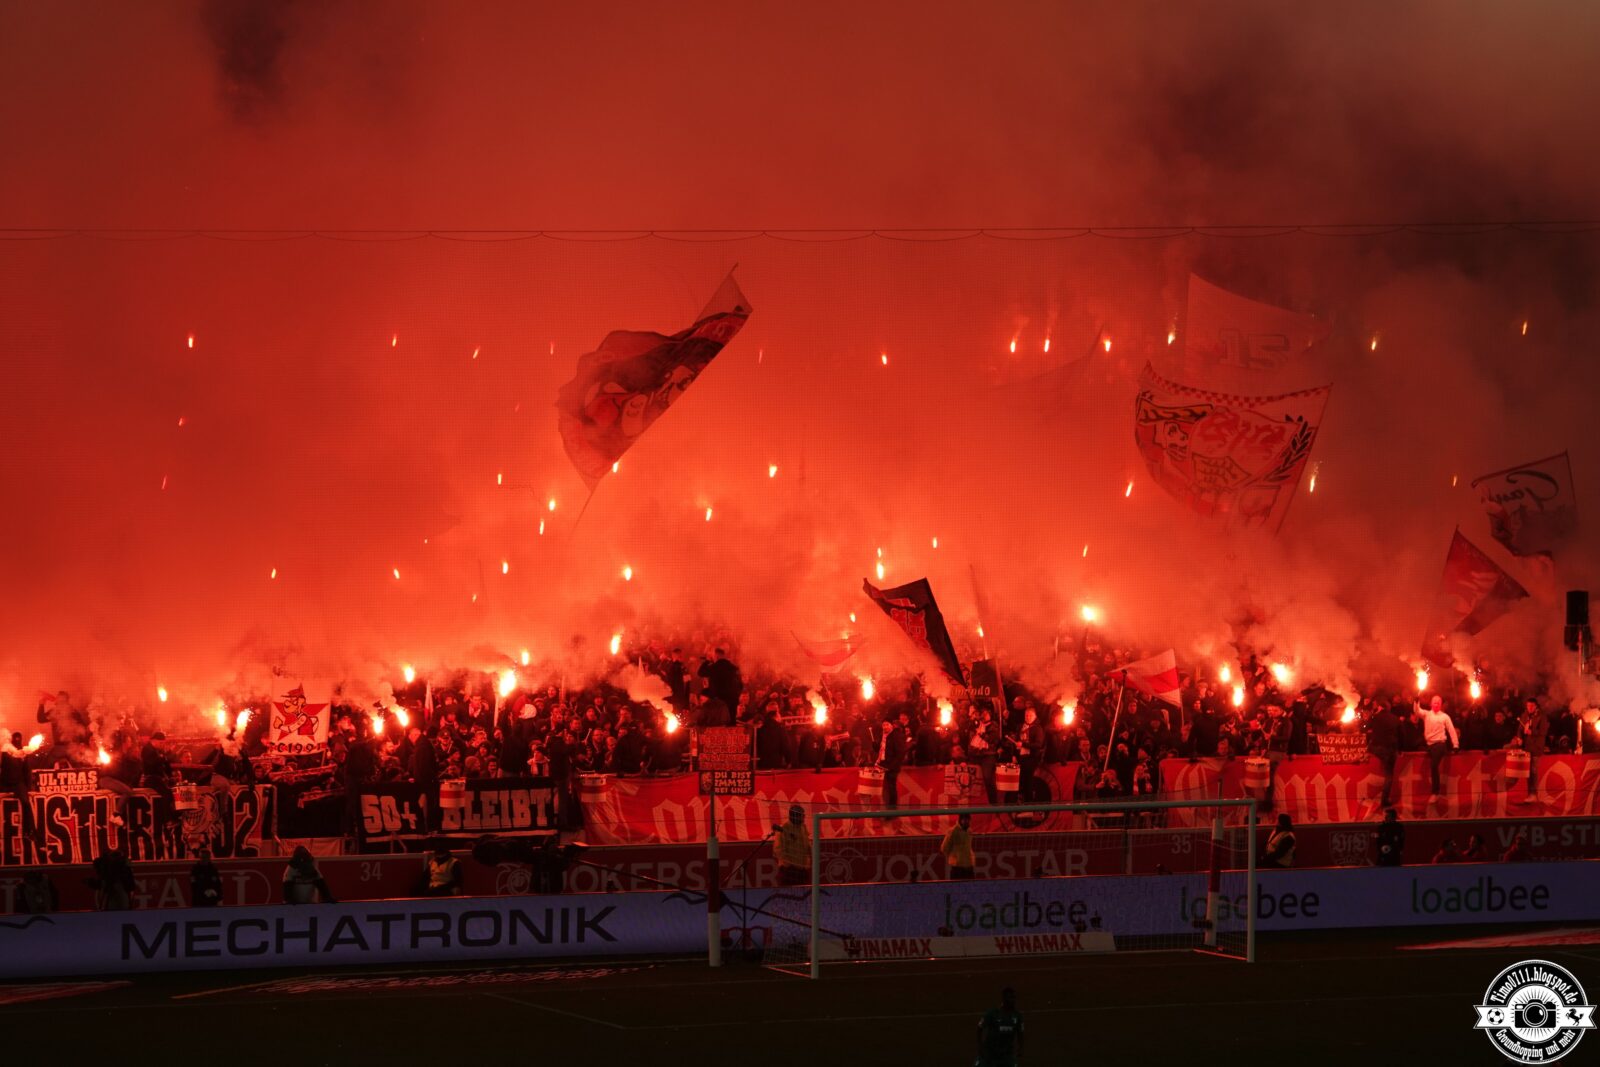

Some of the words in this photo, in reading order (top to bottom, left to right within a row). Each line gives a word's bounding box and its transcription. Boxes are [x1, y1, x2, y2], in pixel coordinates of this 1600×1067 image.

[39, 770, 98, 787] ULTRAS
[714, 771, 728, 779] DU
[731, 771, 752, 779] BIST
[714, 779, 752, 787] IMMER
[360, 792, 428, 834] 50+1
[1171, 834, 1192, 854] 35
[1496, 824, 1600, 848] VfB-ST
[361, 861, 383, 881] 34
[868, 848, 1089, 883] JOKRSTAR
[1411, 876, 1550, 914] loadbee
[946, 891, 1088, 930] loadbee
[121, 906, 618, 960] MECHATRONIK
[995, 933, 1084, 954] WINAMAX
